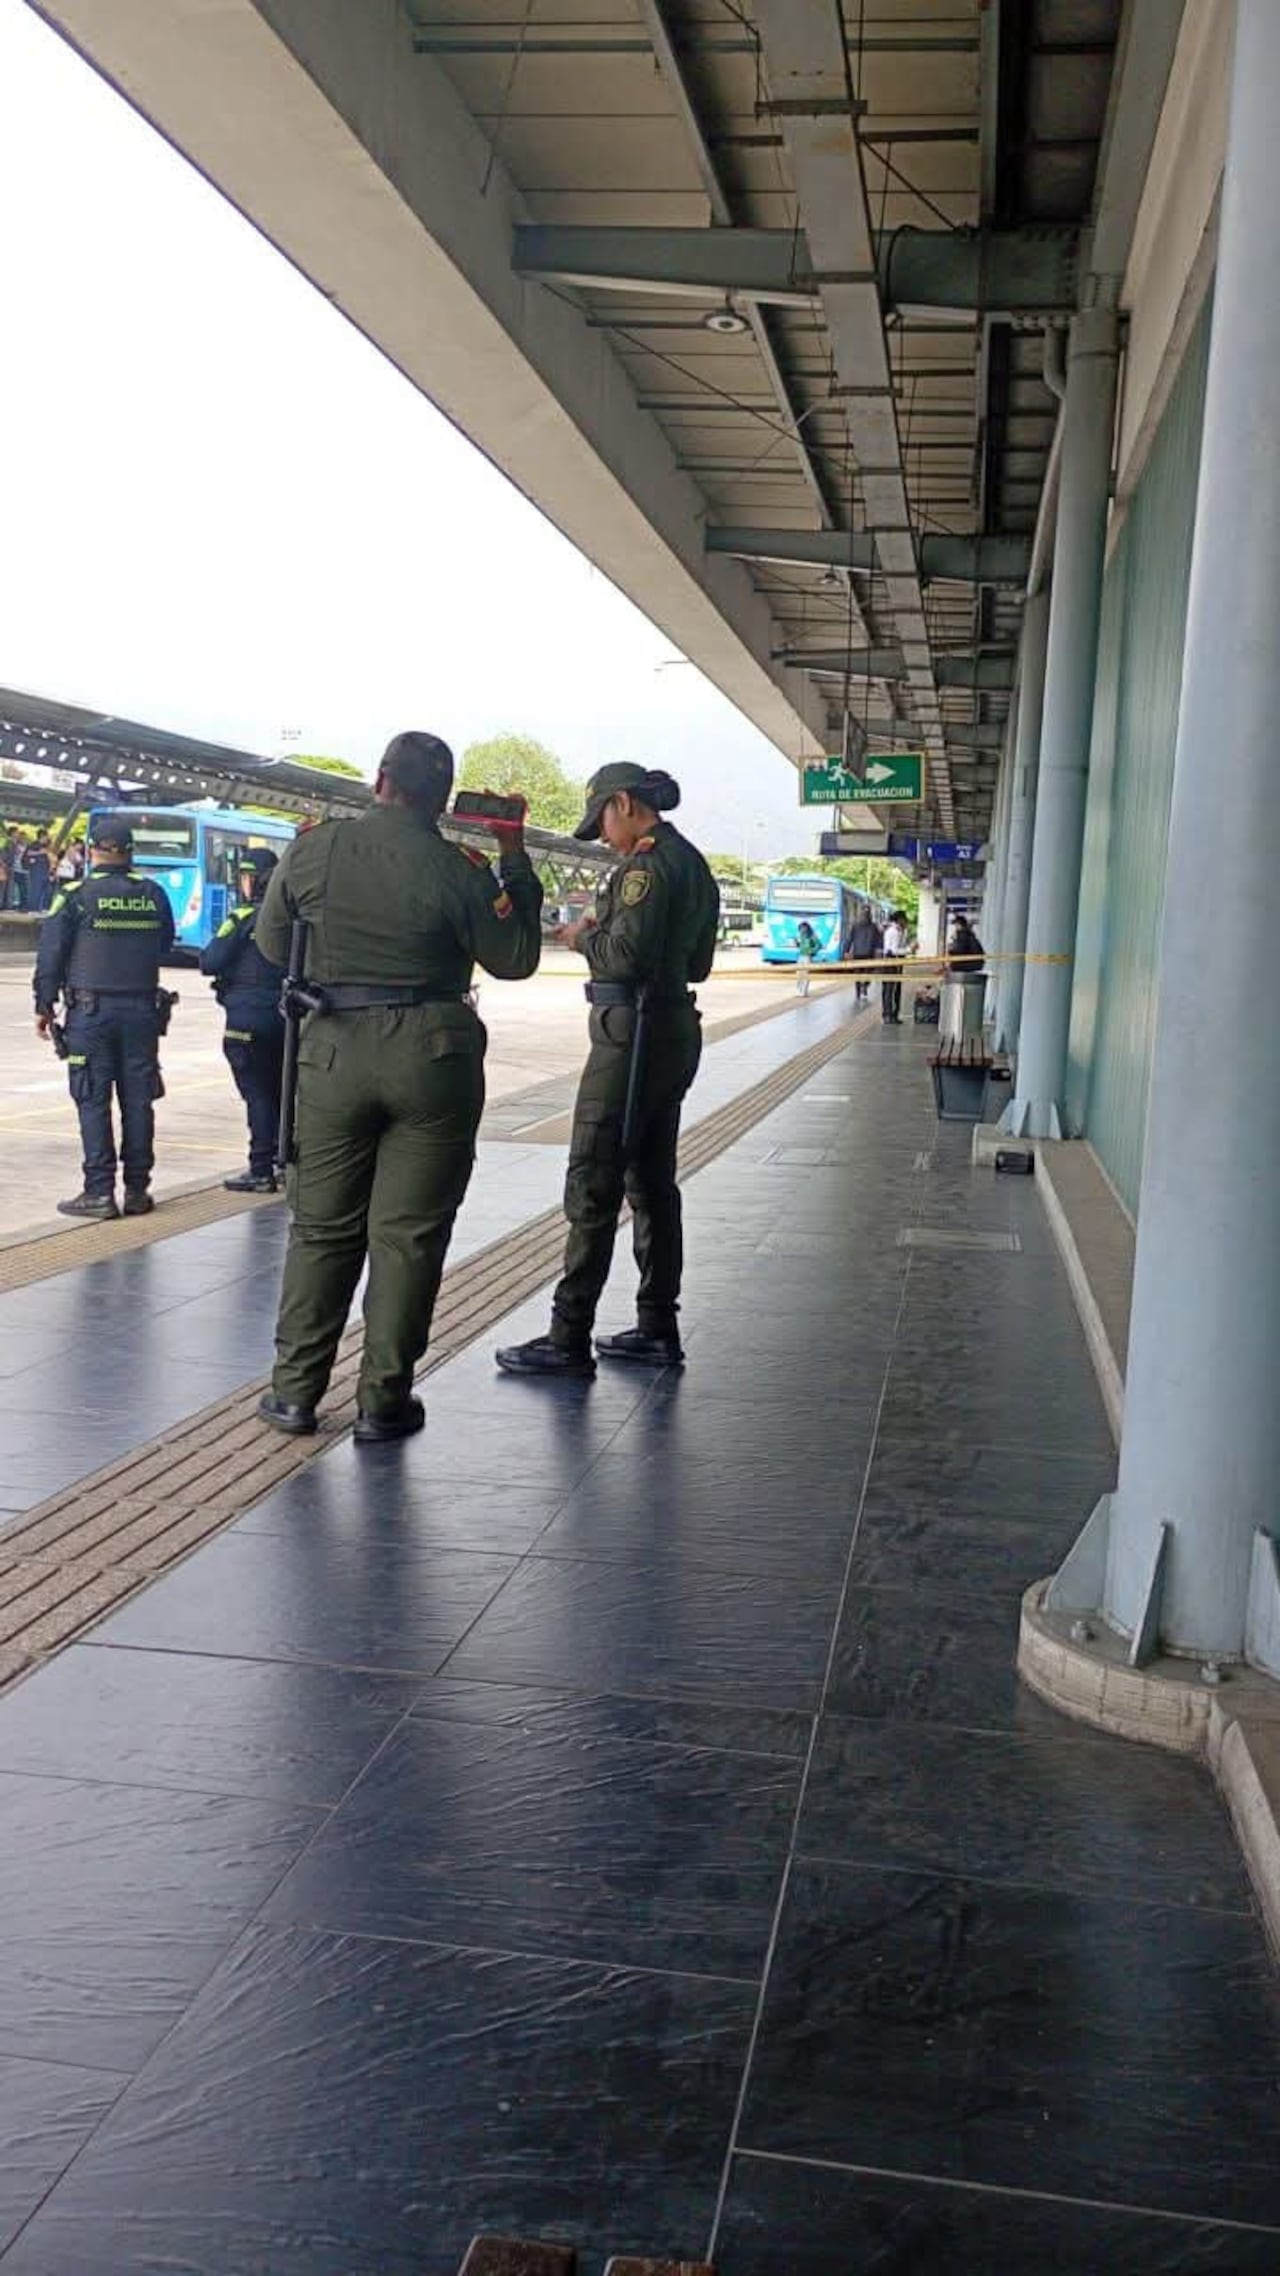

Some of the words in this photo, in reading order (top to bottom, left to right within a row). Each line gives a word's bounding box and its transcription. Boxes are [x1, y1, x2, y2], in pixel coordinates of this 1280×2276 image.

[812, 789, 836, 799] RUTA
[838, 788, 851, 799] DE
[98, 896, 157, 911] POLICÍA
